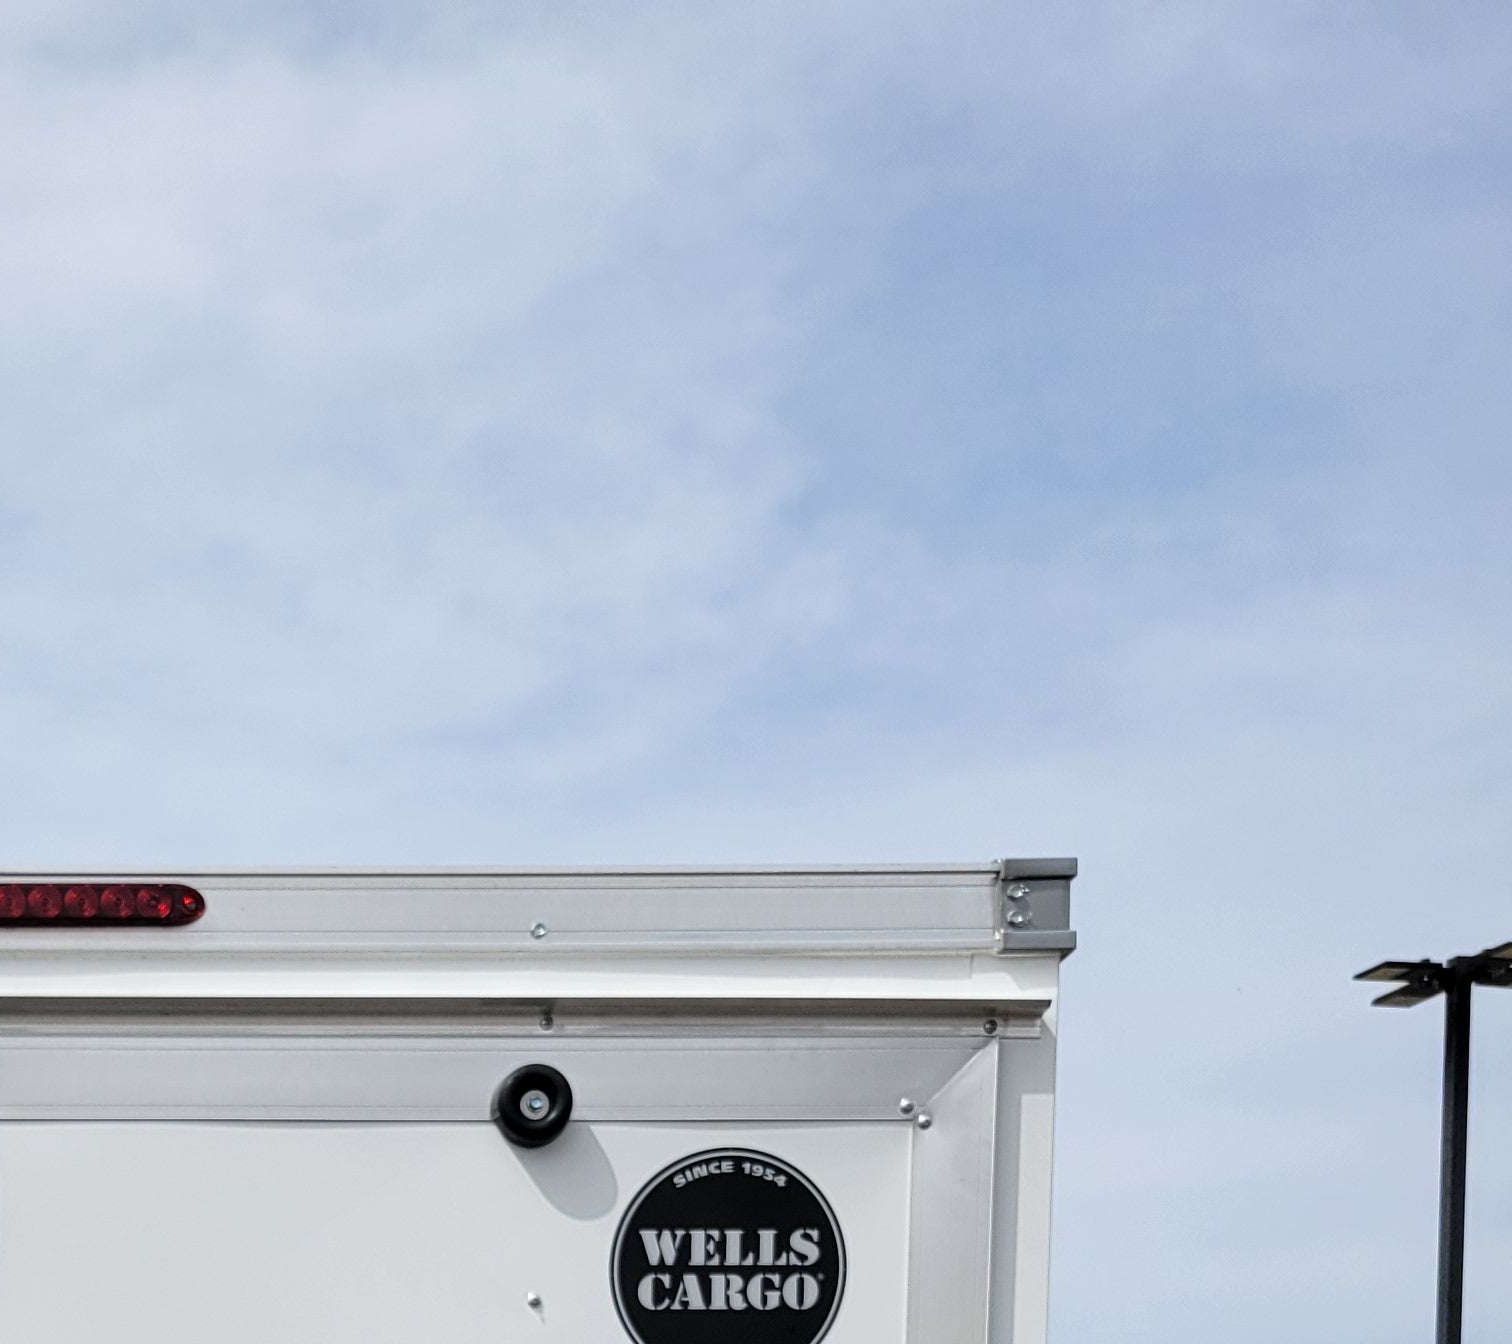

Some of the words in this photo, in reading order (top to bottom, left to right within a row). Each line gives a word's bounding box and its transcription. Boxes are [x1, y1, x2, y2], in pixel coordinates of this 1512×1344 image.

[672, 1161, 735, 1188] SINCE
[741, 1162, 788, 1188] 1954
[638, 1228, 821, 1267] WELLS
[637, 1272, 820, 1311] CARGO
